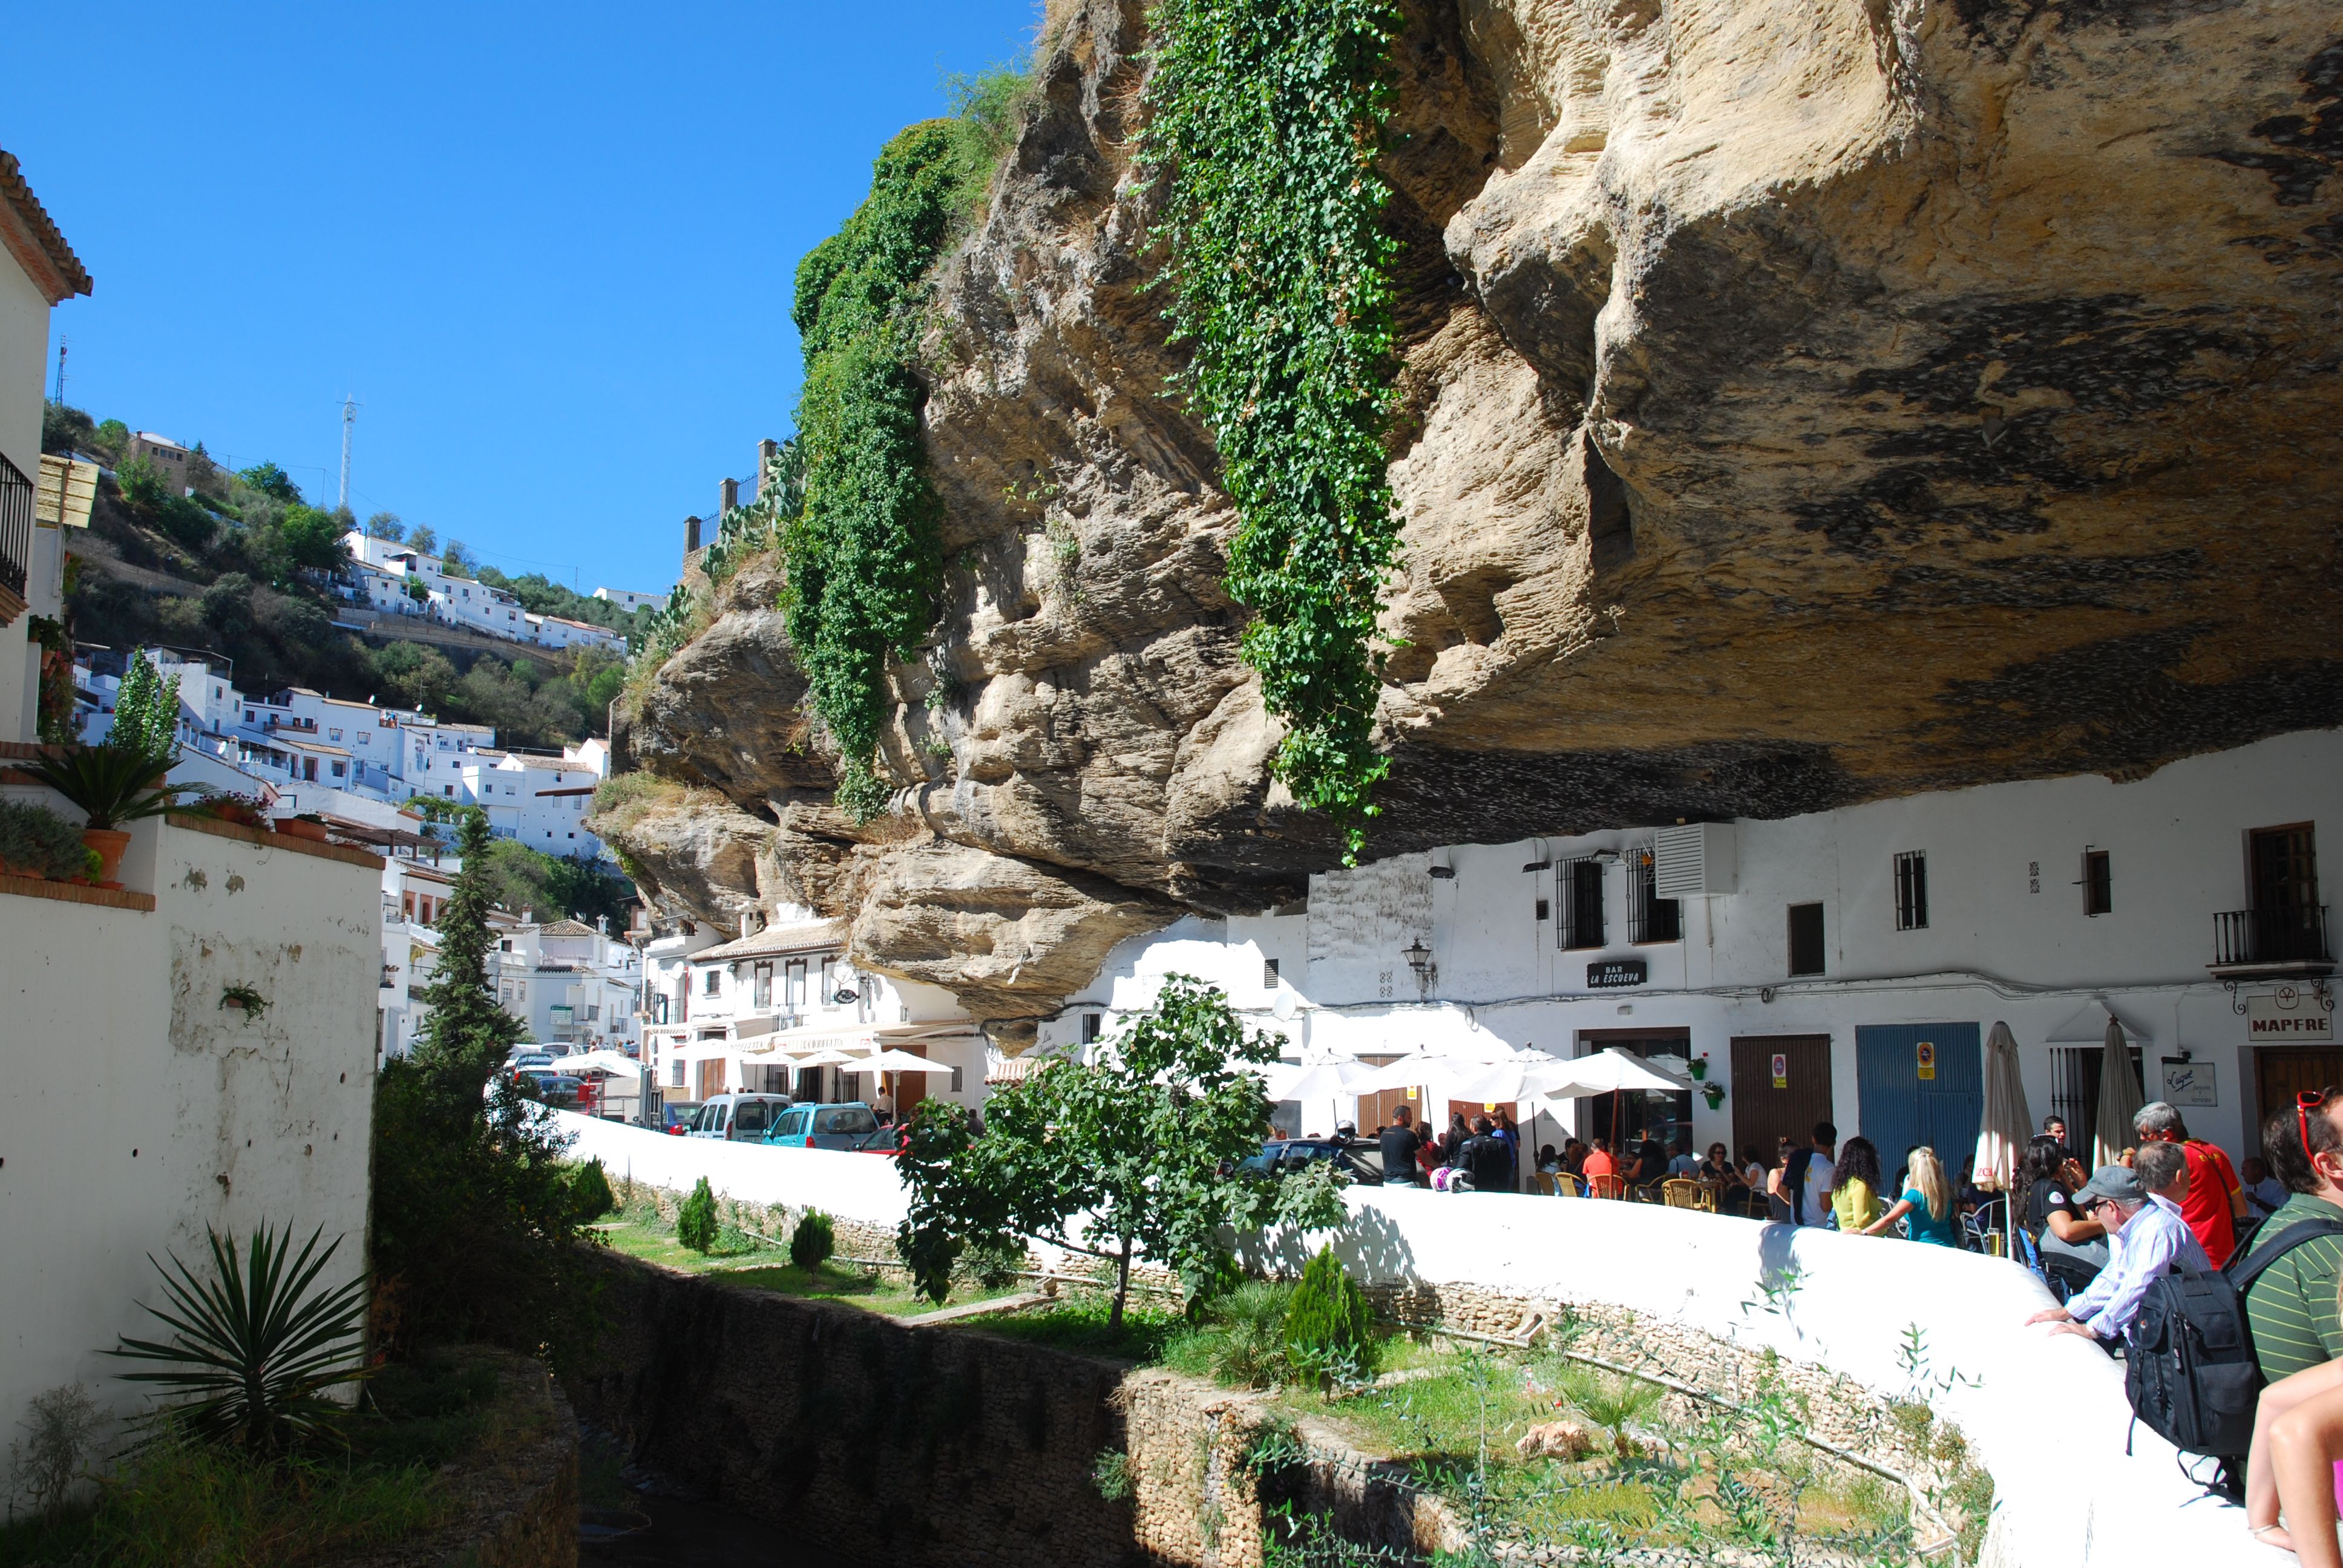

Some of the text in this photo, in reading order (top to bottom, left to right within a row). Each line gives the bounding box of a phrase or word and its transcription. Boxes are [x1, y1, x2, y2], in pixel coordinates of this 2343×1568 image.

[1590, 973, 1639, 984] LA ESCUEVA
[2252, 1018, 2328, 1032] MAPFRE
[1042, 1030, 1051, 1044] La
[2167, 1070, 2194, 1092] Luque
